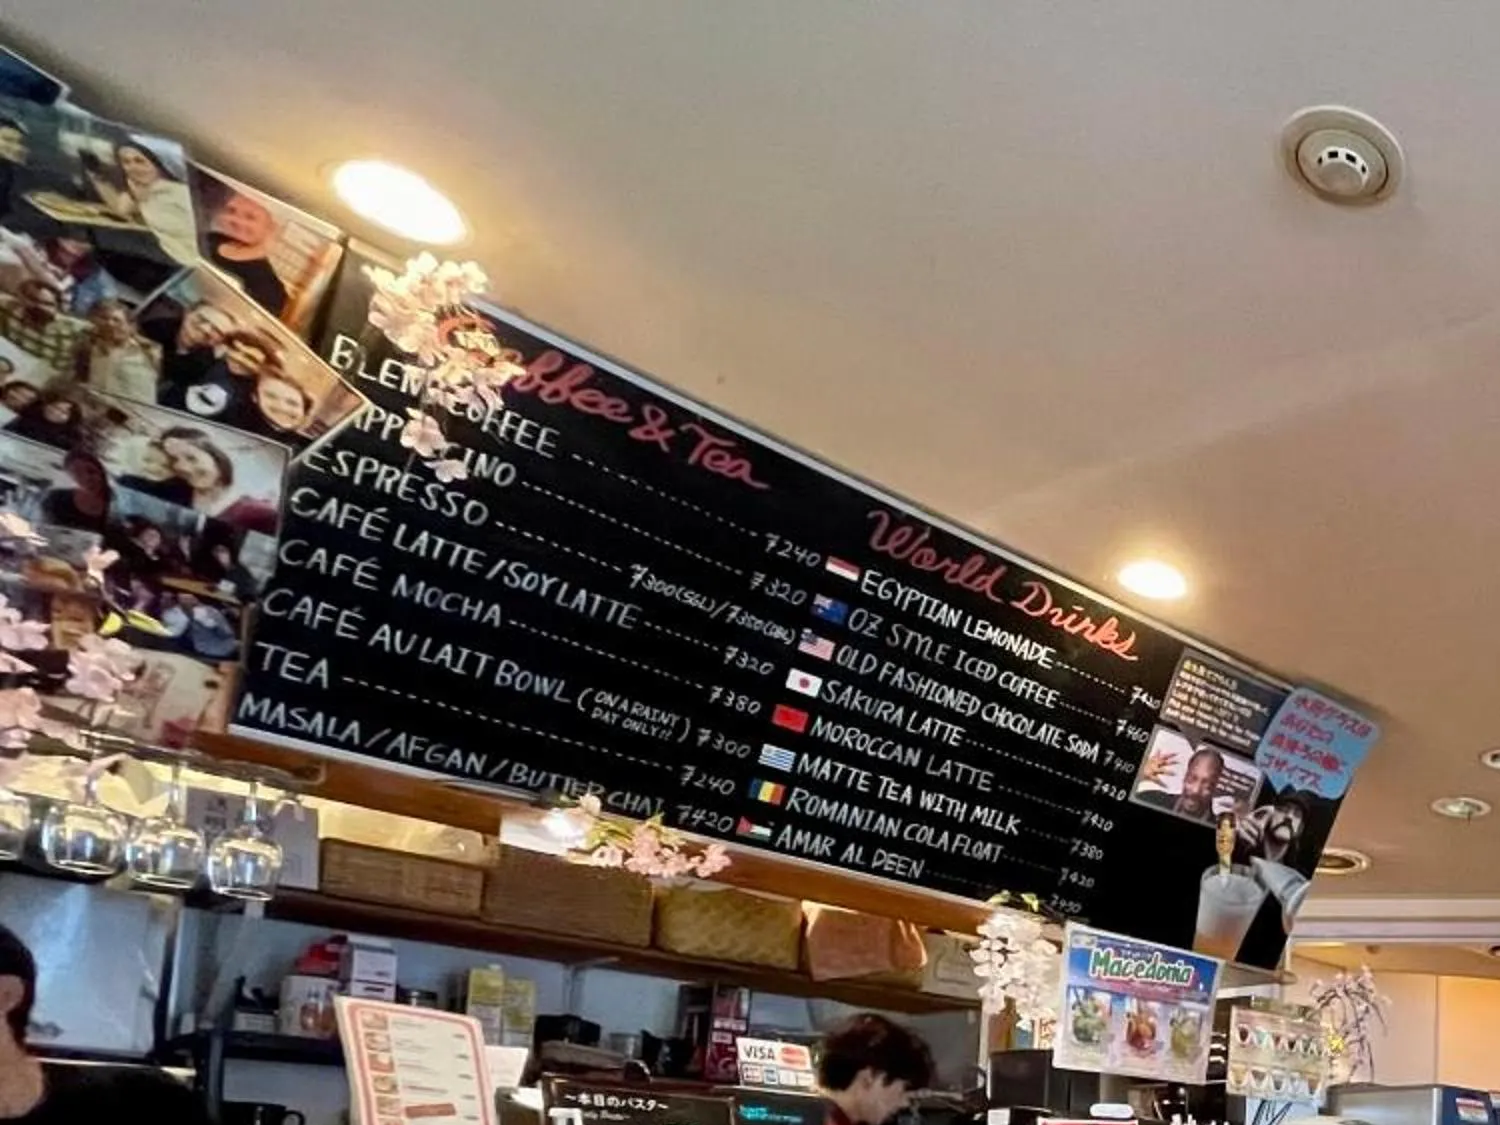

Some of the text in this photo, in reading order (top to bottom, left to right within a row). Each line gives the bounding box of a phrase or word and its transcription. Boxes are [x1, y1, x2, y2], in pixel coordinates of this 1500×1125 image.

[302, 443, 490, 526] ESPRESSO
[628, 404, 676, 453] &
[679, 422, 771, 490] Tea
[290, 486, 391, 542] CAFÉ
[279, 538, 382, 592] CAFÉ
[390, 573, 502, 628] MOCHA
[860, 568, 964, 628] EGYPTIAN
[962, 614, 1057, 670] LEMONADE
[866, 509, 1140, 662] World Drinks
[255, 640, 330, 689] TEA
[262, 588, 366, 641] CAFÉ
[368, 622, 418, 654] AU
[418, 637, 495, 680] LAIT
[494, 659, 572, 703] BOWL
[847, 607, 884, 638] OZ
[885, 623, 953, 665] STYLE
[953, 649, 998, 683] ICED
[998, 671, 1061, 709] COFFEE
[821, 679, 905, 728] SAKURA
[905, 710, 967, 747] LATTE
[836, 644, 878, 675] OLD
[877, 660, 982, 717] FASHIONED
[981, 702, 1067, 749] CHOCOLATE
[1063, 733, 1101, 763] SODA
[797, 752, 873, 793] MATTE
[877, 775, 912, 805] TEA
[918, 790, 968, 822] WITH
[970, 805, 1022, 837] MILK
[809, 714, 922, 767] MOROCCAN
[925, 753, 995, 792] LATTE
[775, 824, 837, 857] AMAR
[840, 842, 867, 866] AL
[871, 848, 926, 880] DEEN
[785, 786, 902, 838] ROMANIAN
[903, 823, 952, 854] COLA
[951, 833, 1004, 864] FLOAT
[1089, 947, 1196, 987] Macedonia
[743, 1044, 777, 1061] VISA
